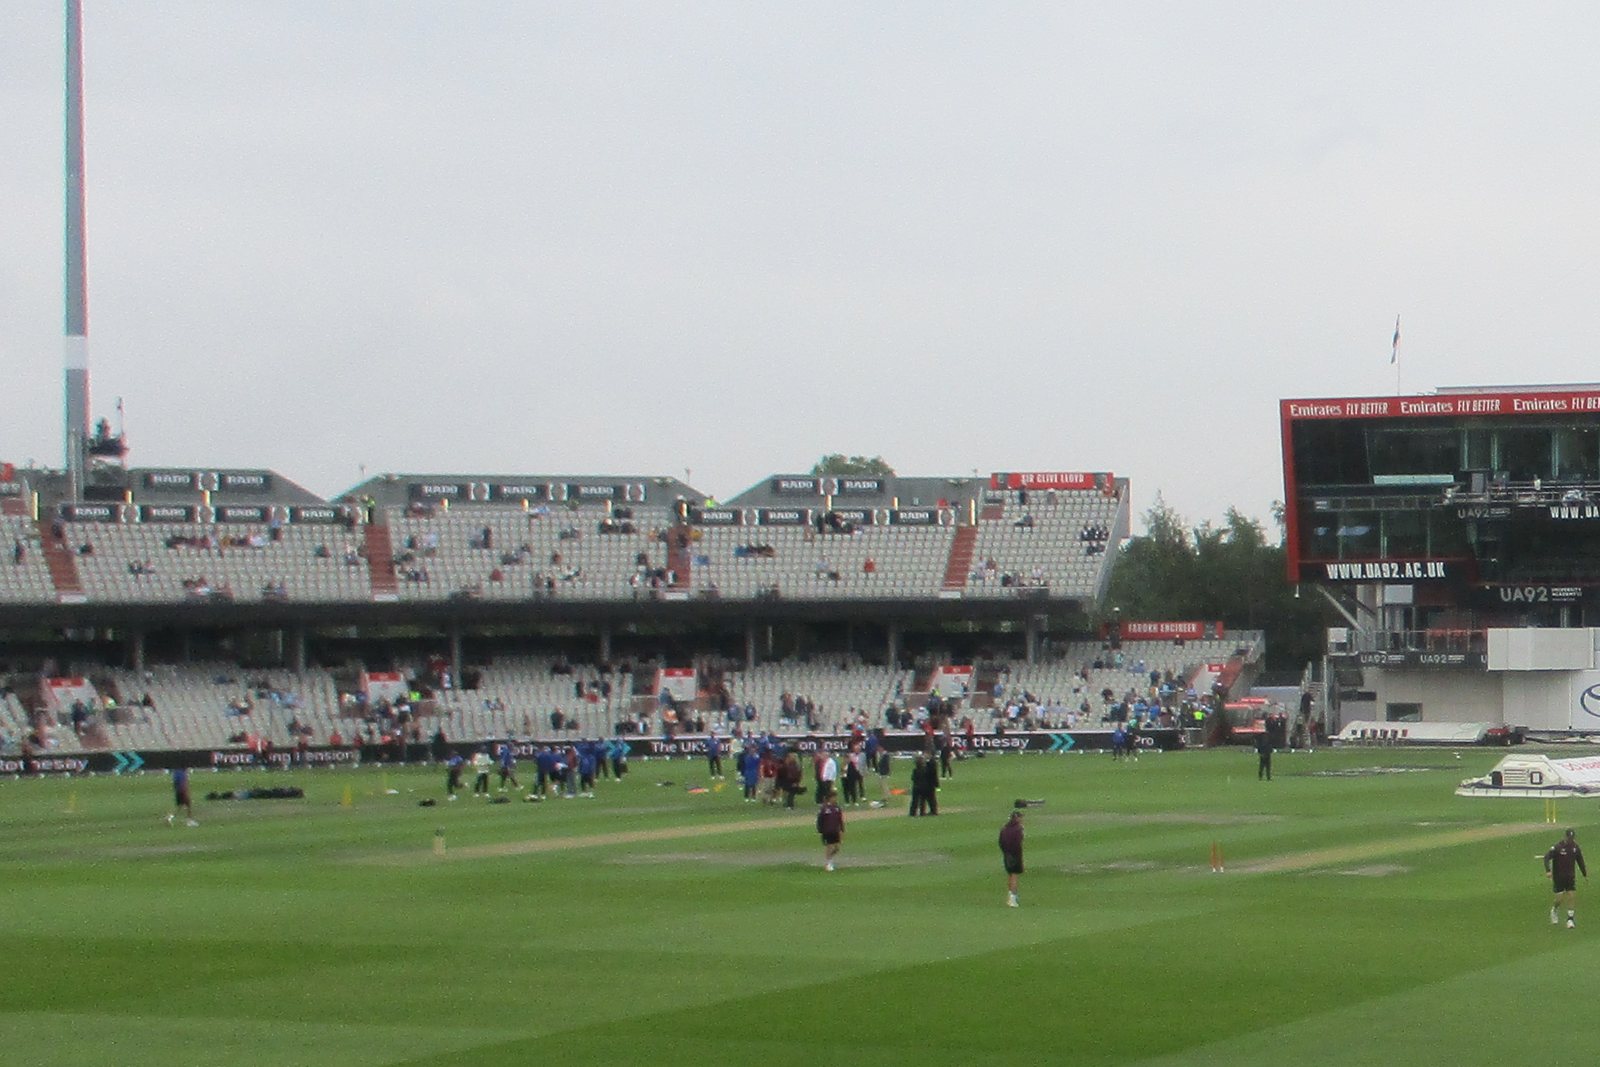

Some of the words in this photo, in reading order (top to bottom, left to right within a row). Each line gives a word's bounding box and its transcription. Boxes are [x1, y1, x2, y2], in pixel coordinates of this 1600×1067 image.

[1290, 403, 1341, 416] Emirates
[1346, 403, 1359, 415] FLY
[1361, 402, 1388, 415] BETTER
[1400, 401, 1453, 413] Emirates
[1457, 400, 1470, 412] FLY
[1472, 399, 1500, 412] BETTER
[1513, 398, 1567, 411] Emirates
[1571, 397, 1584, 409] FLY
[782, 481, 813, 489] RADO
[846, 481, 878, 489] RADO
[1458, 507, 1489, 519] UA92
[1326, 562, 1446, 579] WWW.UA92.AC.UK
[1500, 586, 1549, 602] UA92
[1360, 655, 1387, 664] UA92
[1420, 654, 1447, 664] UA92
[652, 742, 677, 753] The
